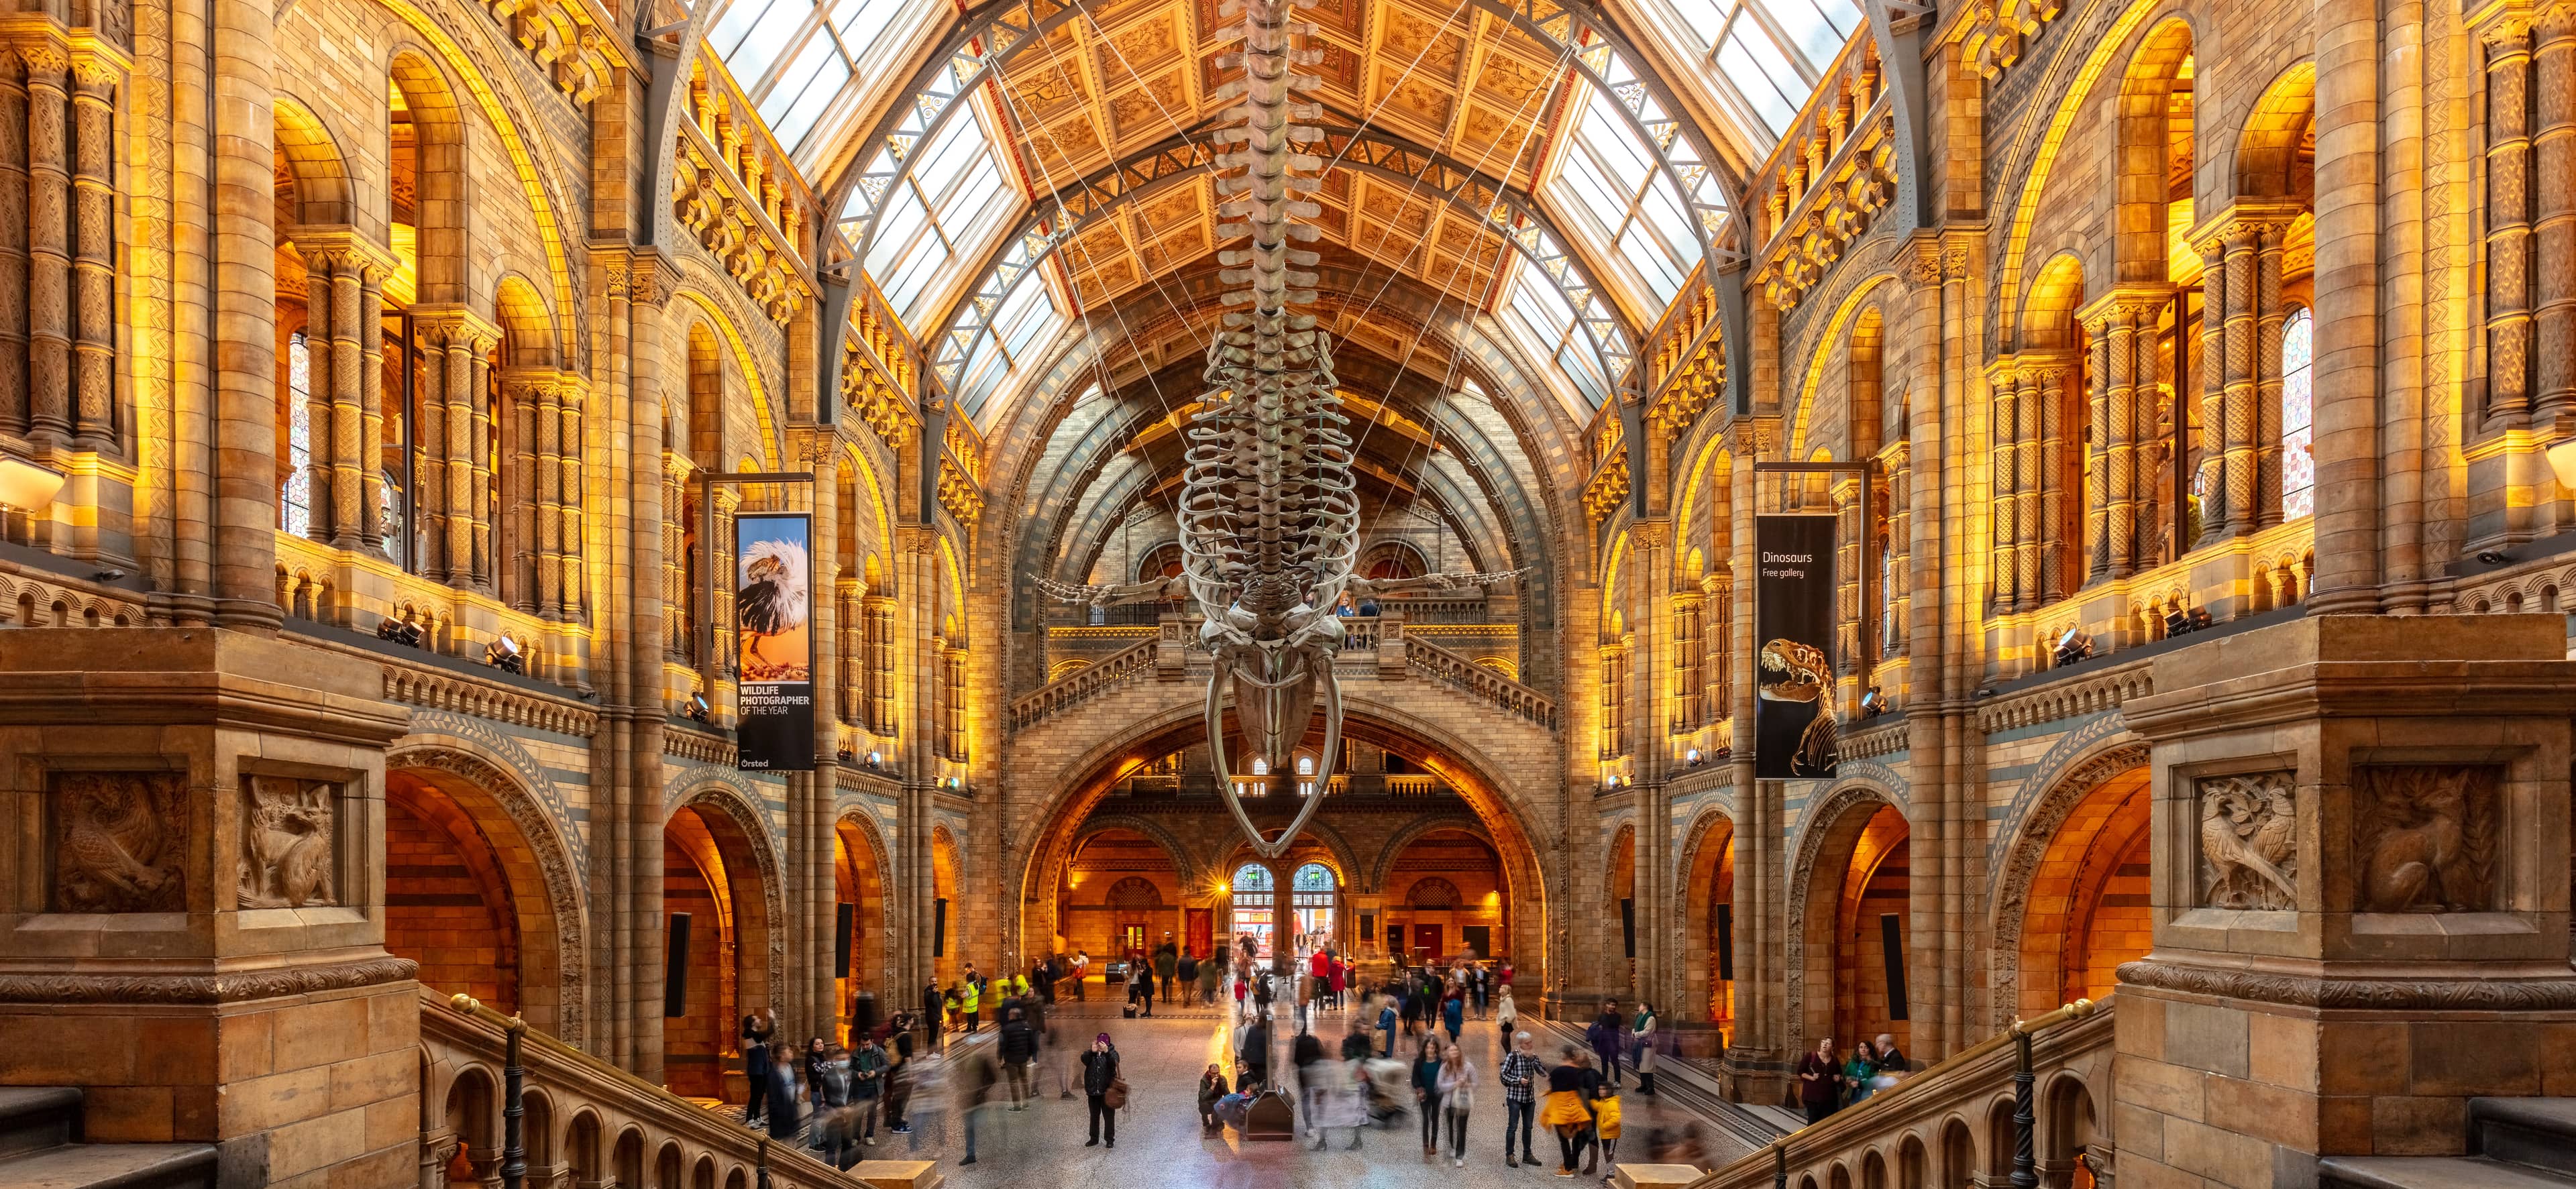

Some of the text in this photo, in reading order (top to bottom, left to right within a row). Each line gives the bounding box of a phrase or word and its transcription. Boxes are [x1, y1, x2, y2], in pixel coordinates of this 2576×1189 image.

[1763, 552, 1812, 563] Dinosaurs
[1763, 569, 1804, 579] Free gallery
[741, 686, 778, 695] WILDLIFE
[741, 696, 809, 705] PHOTOGRAPHER
[741, 706, 788, 715] OF THE YEAR
